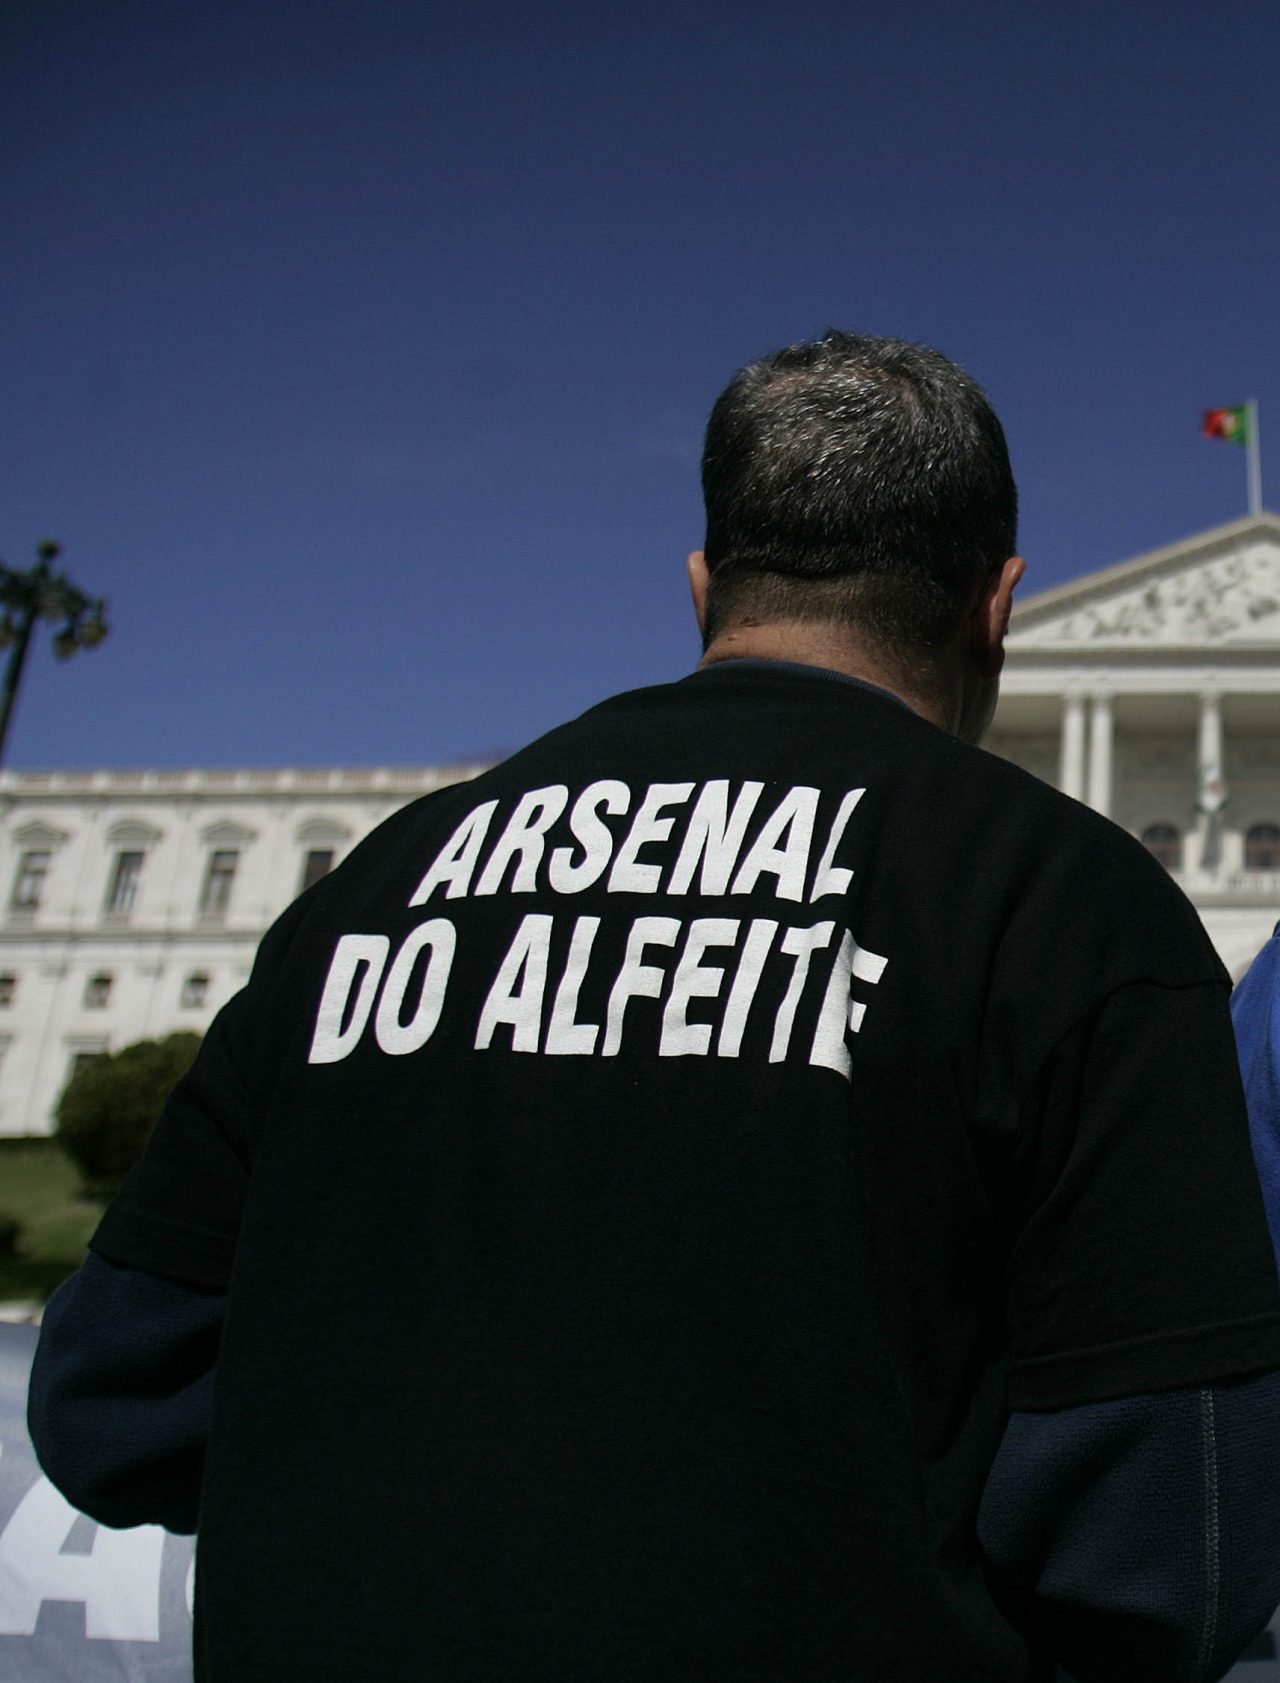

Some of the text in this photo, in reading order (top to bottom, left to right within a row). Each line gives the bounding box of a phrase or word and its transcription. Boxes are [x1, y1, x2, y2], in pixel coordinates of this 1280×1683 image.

[408, 778, 867, 908] ARSENAL
[307, 914, 889, 1080] DO ALFEITE
